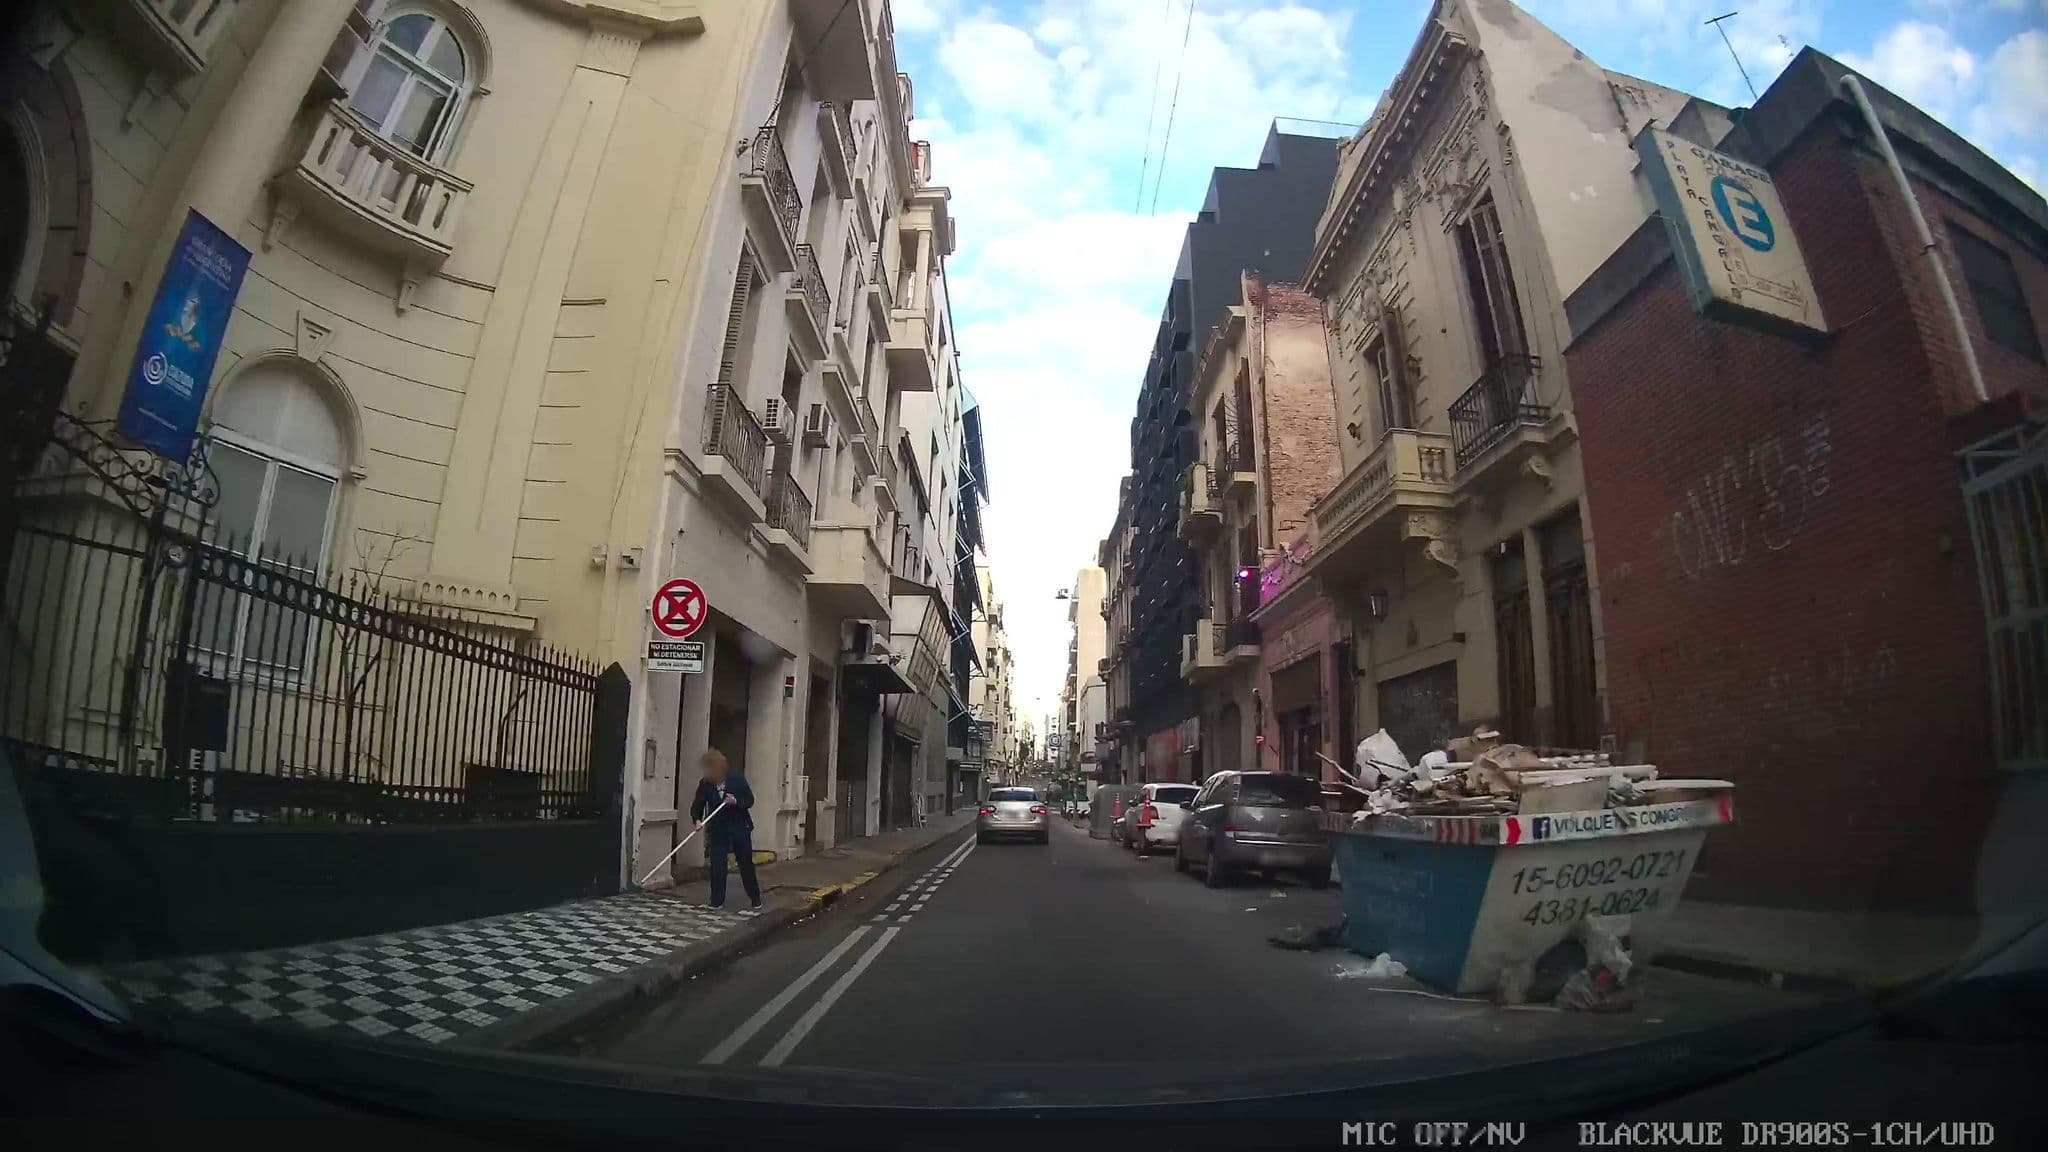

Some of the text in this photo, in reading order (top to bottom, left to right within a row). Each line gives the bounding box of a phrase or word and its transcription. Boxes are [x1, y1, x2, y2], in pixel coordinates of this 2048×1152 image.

[1665, 139, 1698, 199] PLAYA
[1690, 147, 1771, 185] GARAGE
[1721, 183, 1770, 245] E
[661, 643, 701, 651] ESTACIONAR
[1554, 811, 1637, 834] VOLQUES
[1512, 849, 1686, 894] 15-6092-0721
[1523, 887, 1660, 926] 4381-0624
